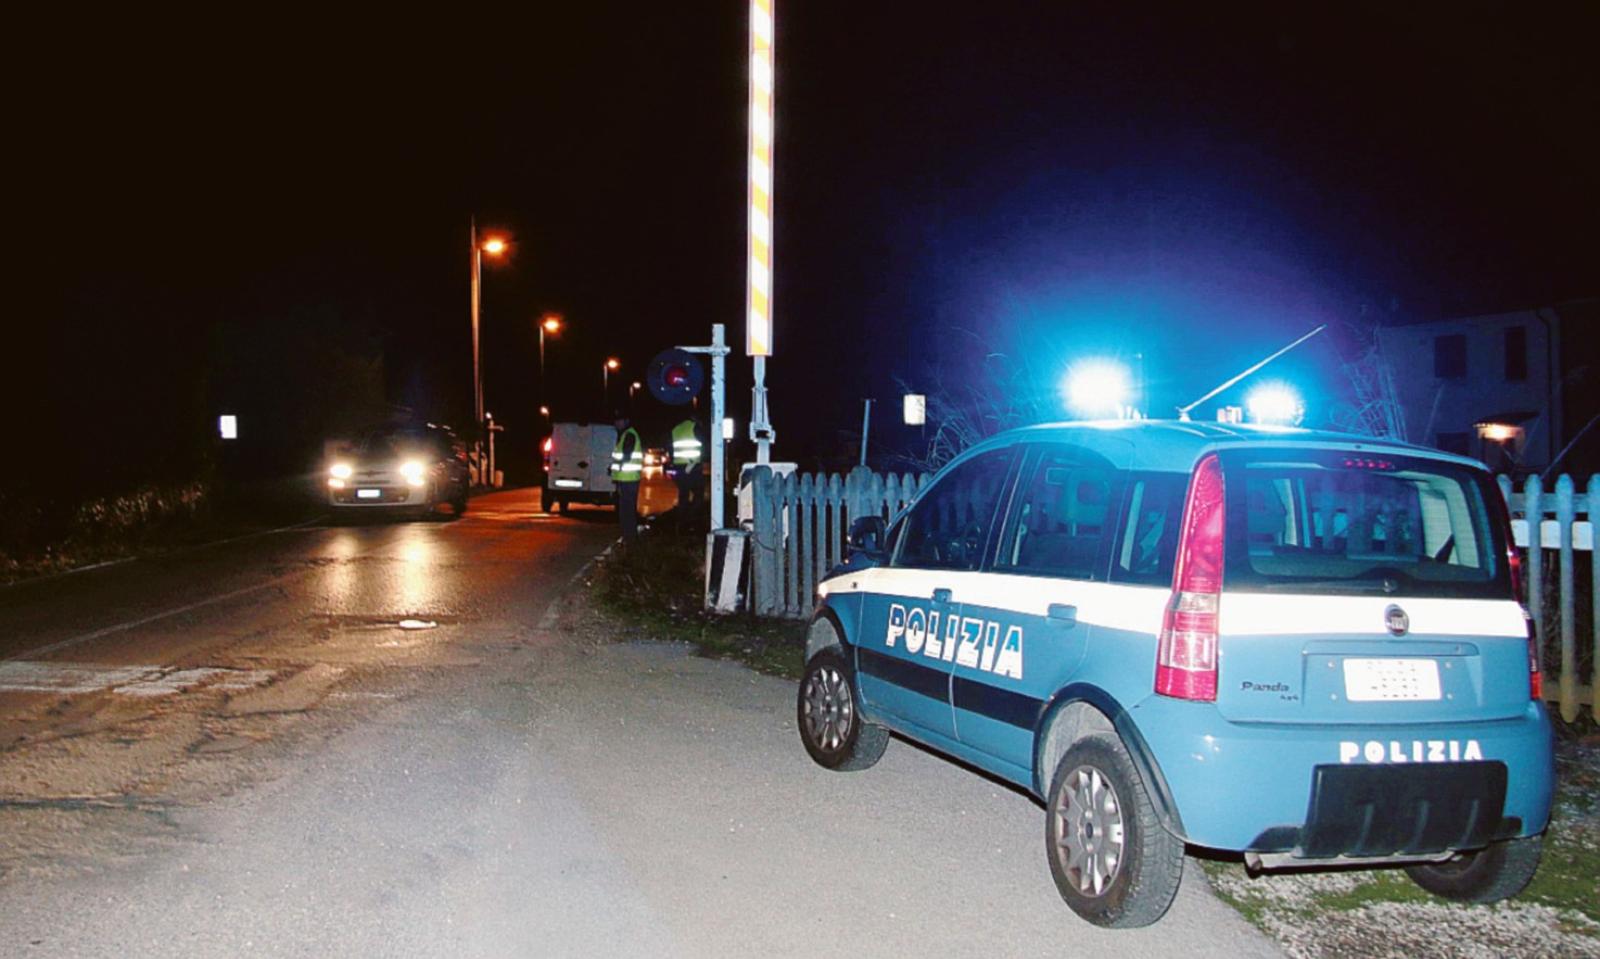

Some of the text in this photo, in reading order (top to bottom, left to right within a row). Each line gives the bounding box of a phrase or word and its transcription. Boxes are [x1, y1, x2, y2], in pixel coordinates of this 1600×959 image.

[886, 604, 1023, 680] POLIZIA
[1240, 681, 1290, 691] Panda
[1340, 740, 1482, 764] POLIZIA
